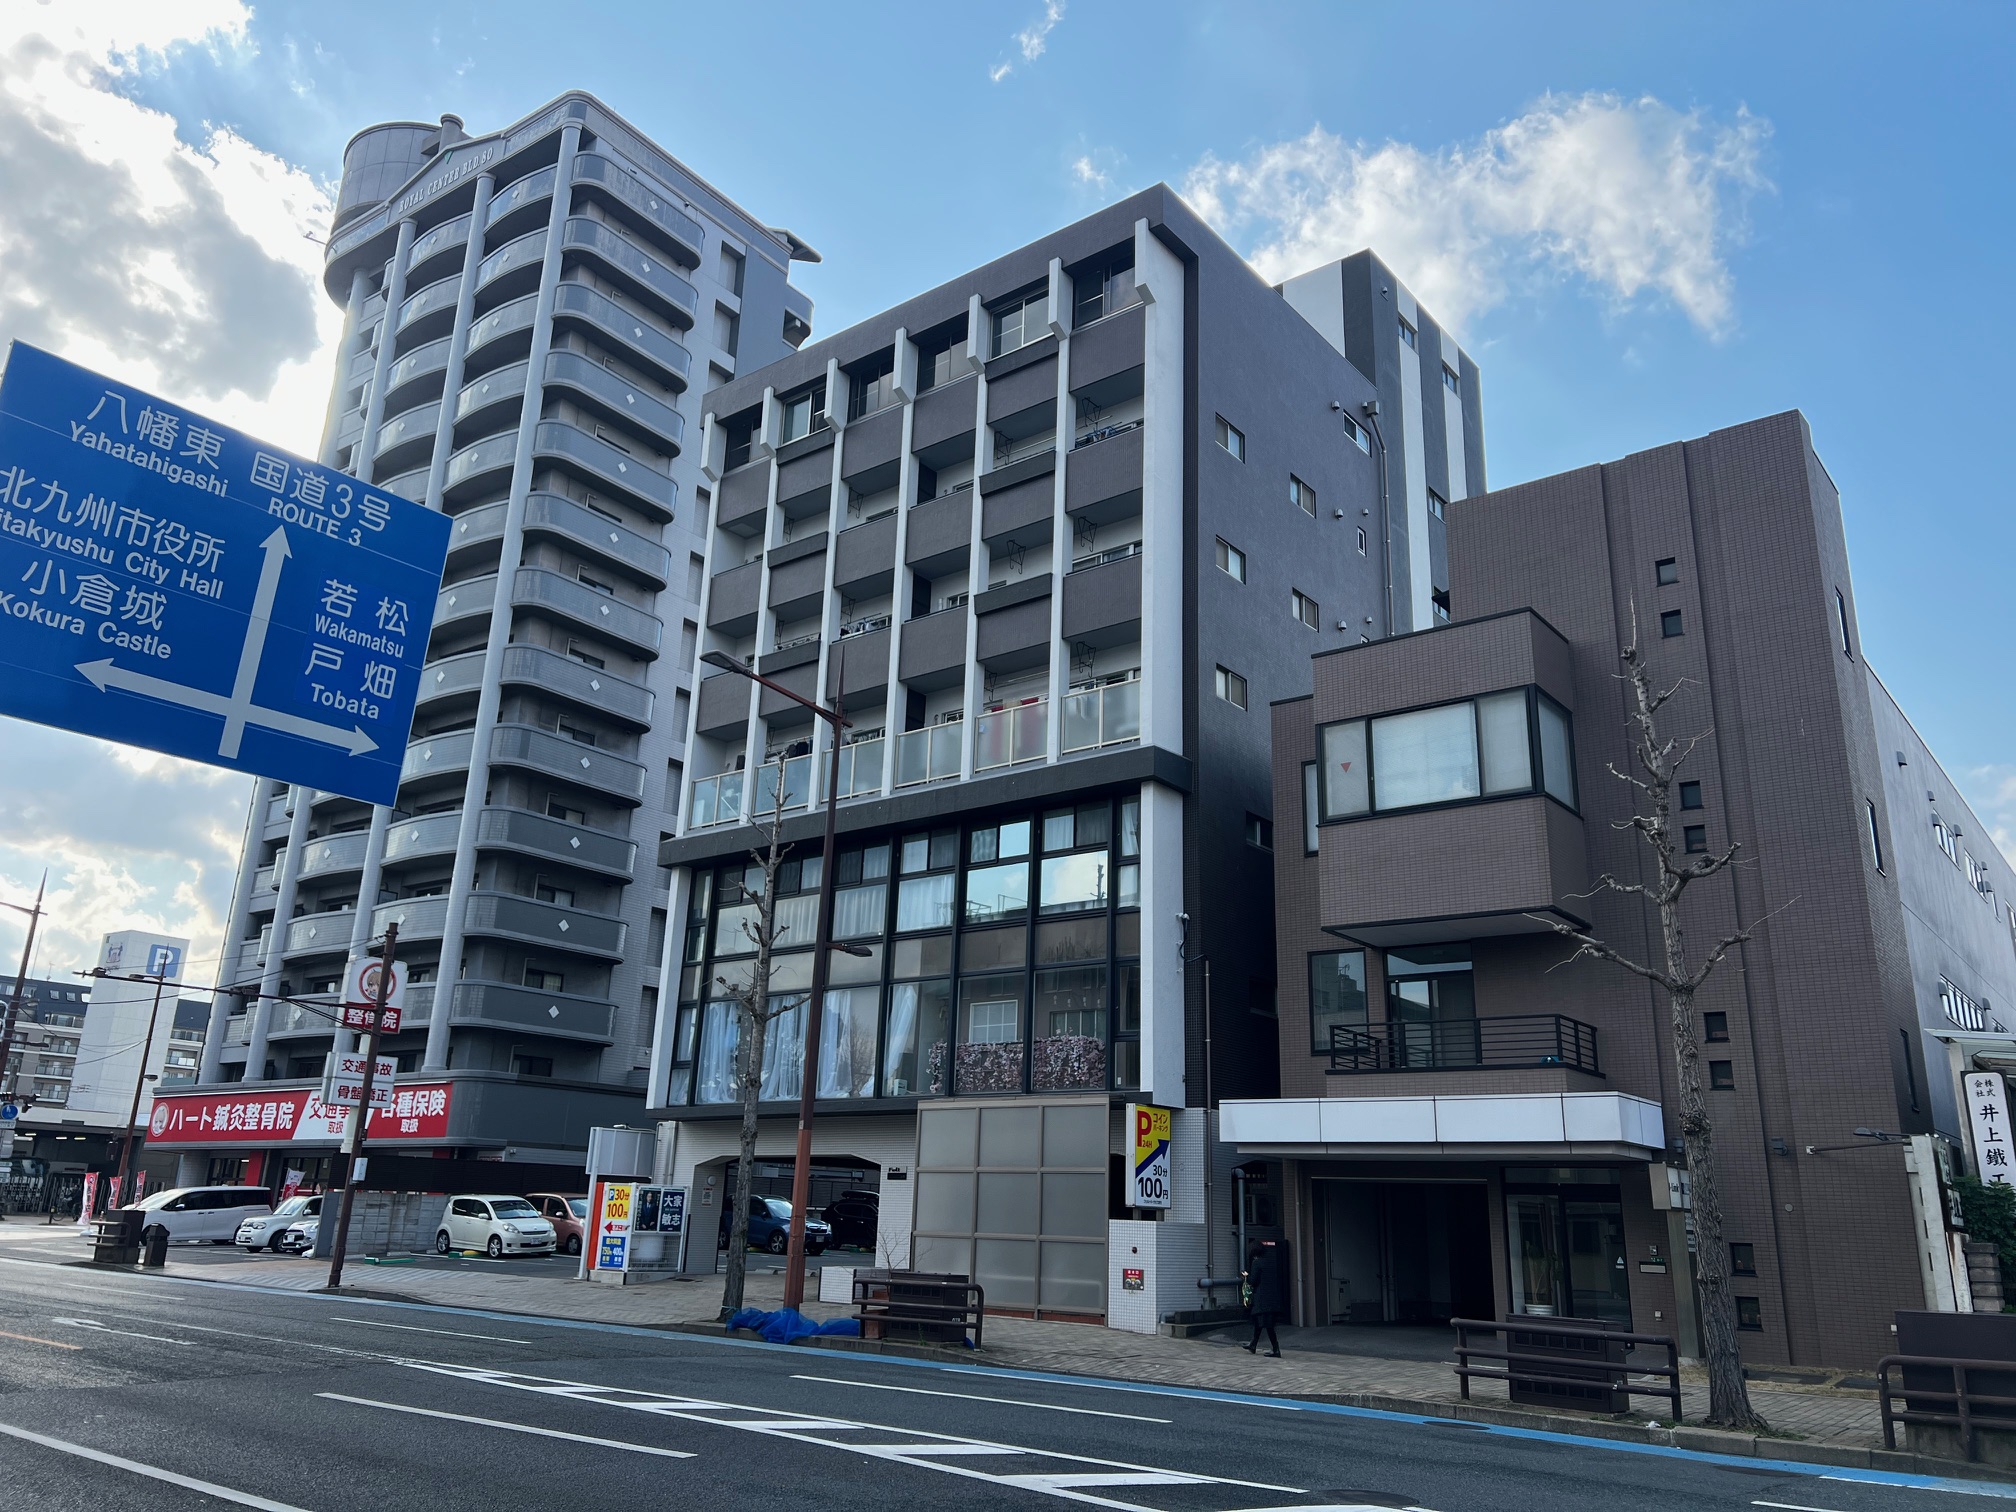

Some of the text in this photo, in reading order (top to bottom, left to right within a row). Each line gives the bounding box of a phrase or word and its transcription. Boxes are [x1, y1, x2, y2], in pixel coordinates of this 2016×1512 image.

[399, 188, 424, 214] ROYAL
[427, 166, 460, 196] CENTER
[482, 147, 494, 164] 80
[86, 390, 226, 470] 八幡東
[70, 420, 229, 498] Yahatahigashi
[250, 451, 391, 532] 国道3号
[0, 465, 226, 573] 北九州市役所
[268, 497, 362, 547] ROUTE 3
[125, 551, 171, 585] City
[179, 569, 224, 600] Hall
[21, 559, 168, 631] 小倉城
[320, 578, 409, 637] 若松
[0, 590, 172, 659] Kokura Castle
[315, 613, 404, 659] Wakamatsu
[304, 642, 397, 700] 戸畑
[311, 682, 380, 720] Tobata
[152, 947, 174, 973] P
[169, 1101, 295, 1131] ハート鍼灸整骨院
[381, 1089, 447, 1118] 各種保険
[1153, 1113, 1168, 1124] コイン
[400, 1118, 419, 1133] 取扱
[1137, 1110, 1152, 1147] P
[1142, 1140, 1152, 1148] 24H
[1138, 1177, 1169, 1199] 100円
[1152, 1165, 1168, 1177] 30分
[607, 1203, 628, 1218] 100円
[615, 1189, 630, 1201] 30分
[663, 1195, 683, 1208] 大家
